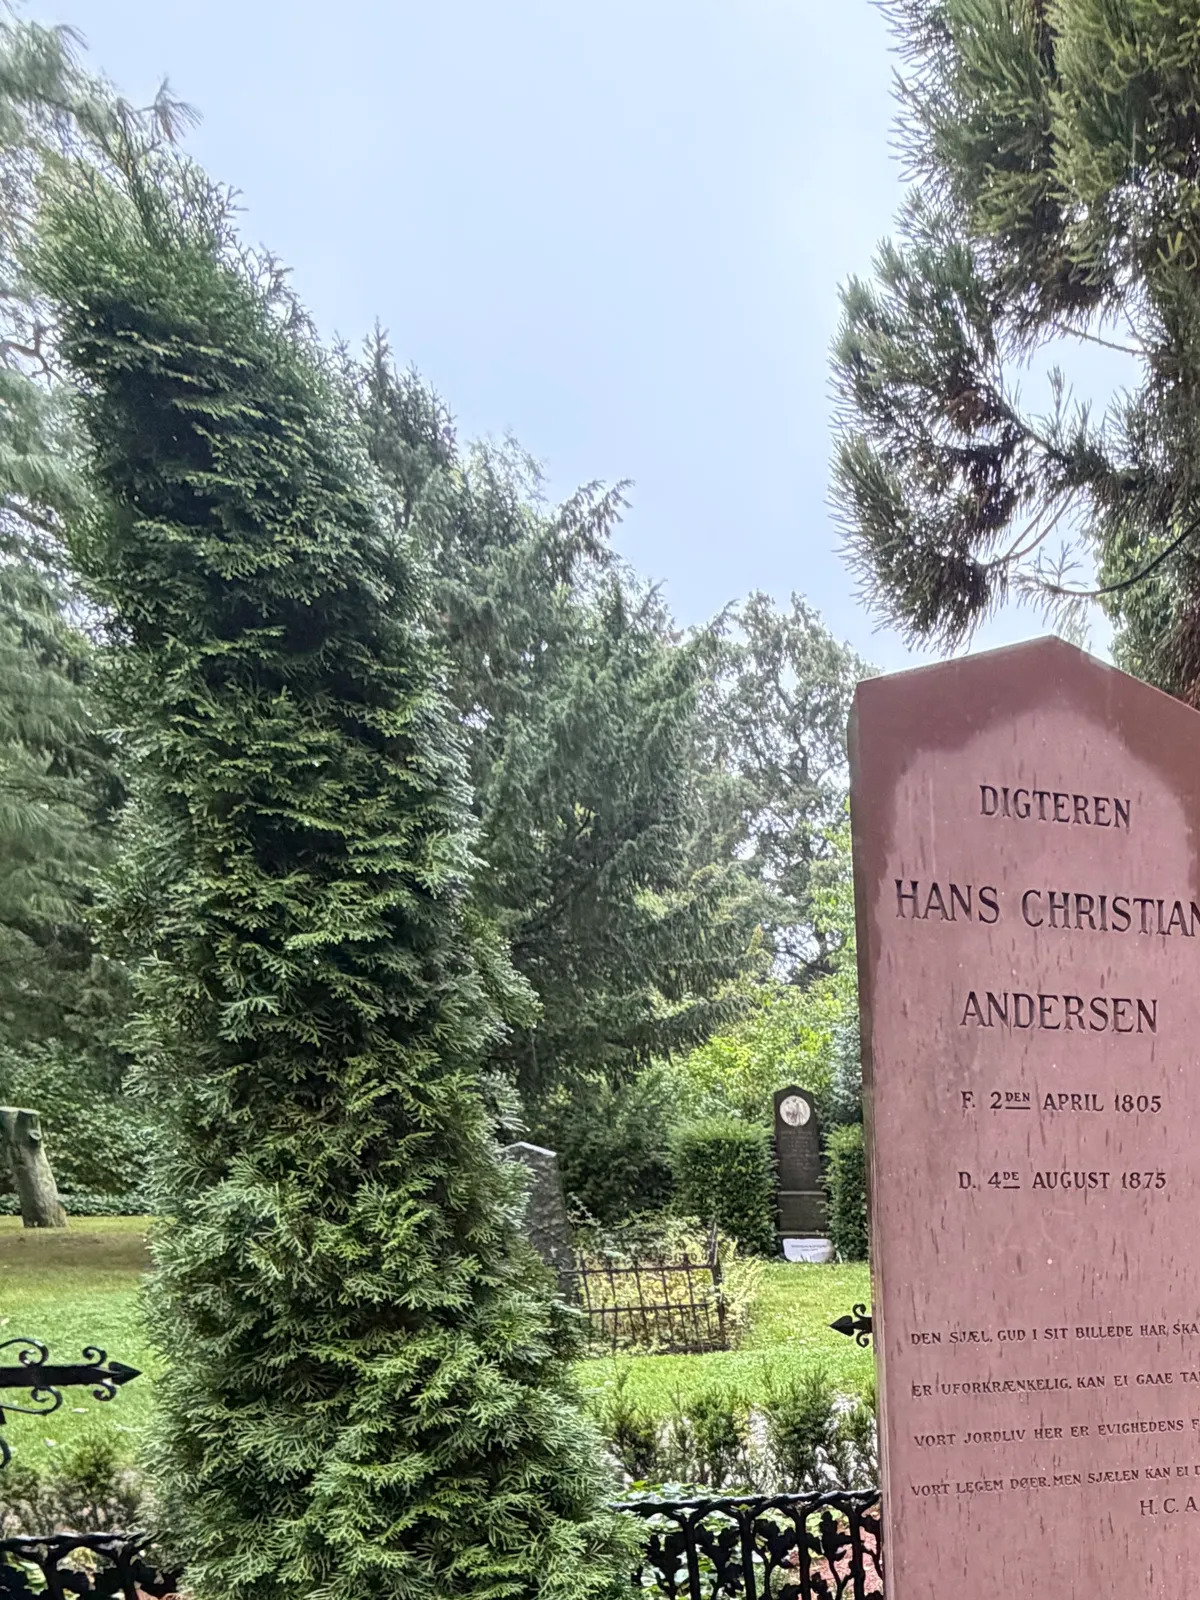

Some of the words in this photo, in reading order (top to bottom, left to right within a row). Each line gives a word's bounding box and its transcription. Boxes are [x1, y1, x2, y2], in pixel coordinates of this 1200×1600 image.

[979, 784, 1132, 829] DIGTEREN
[894, 879, 1001, 924] HANS
[959, 990, 1160, 1034] ANDERSEN
[960, 1091, 975, 1110] F.
[1042, 1093, 1104, 1112] APRIL
[1114, 1095, 1162, 1113] 1805
[958, 1171, 977, 1189] D.
[1032, 1171, 1110, 1189] AUGUST
[1121, 1172, 1167, 1190] 1875
[911, 1332, 941, 1345] DEN
[997, 1329, 1026, 1342] GUD
[1032, 1328, 1038, 1341] I
[1044, 1328, 1068, 1340] SIT
[1075, 1325, 1134, 1339] BILLEDE
[911, 1384, 932, 1397] ER
[1077, 1376, 1105, 1389] KAN
[1114, 1375, 1128, 1387] EI
[1136, 1372, 1173, 1385] GAAE
[914, 1434, 956, 1447] VORT
[964, 1429, 1026, 1444] JORDLIV
[1034, 1427, 1063, 1440] HER
[1070, 1425, 1090, 1438] ER
[1098, 1419, 1184, 1436] EVIGHEDENS
[911, 1484, 950, 1497] VORT
[956, 1479, 1004, 1494] LEGEM
[1053, 1473, 1082, 1487] MEN
[1087, 1469, 1139, 1484] SJÆLEN
[1145, 1467, 1171, 1480] KAN
[1176, 1465, 1189, 1477] EI
[1140, 1498, 1158, 1516] H.
[1163, 1497, 1179, 1514] C.
